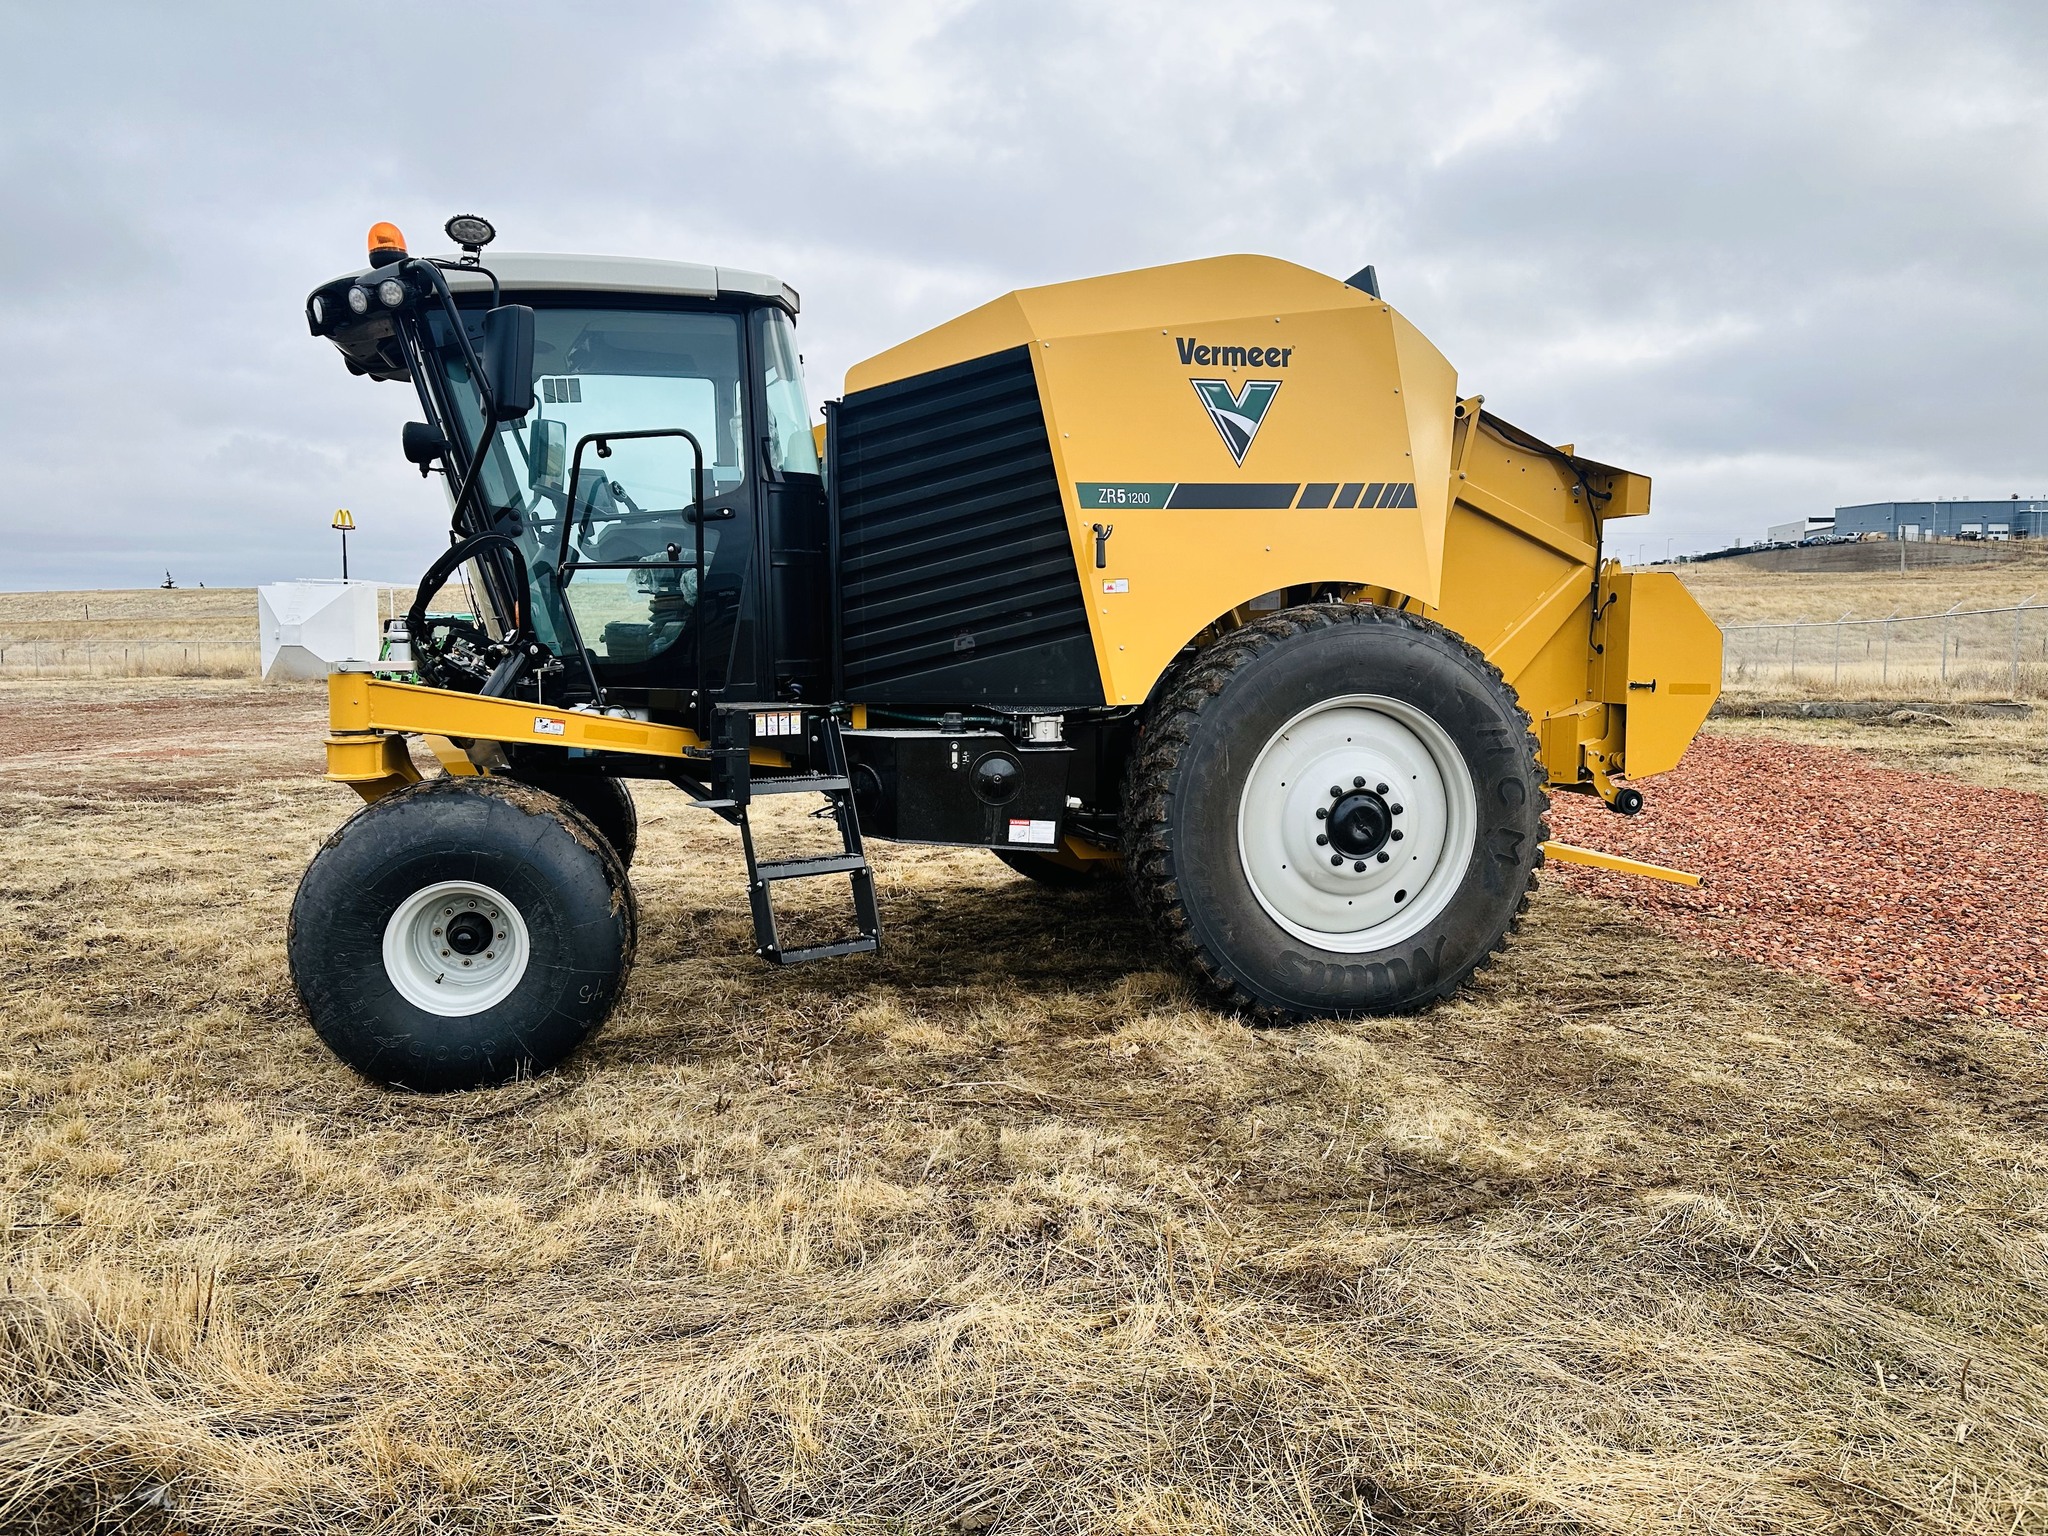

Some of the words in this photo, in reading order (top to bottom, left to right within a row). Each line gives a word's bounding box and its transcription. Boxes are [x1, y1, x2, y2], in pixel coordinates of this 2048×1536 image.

[1175, 337, 1293, 368] Vermeer
[1098, 488, 1126, 504] ZR5
[1127, 492, 1151, 505] 1200
